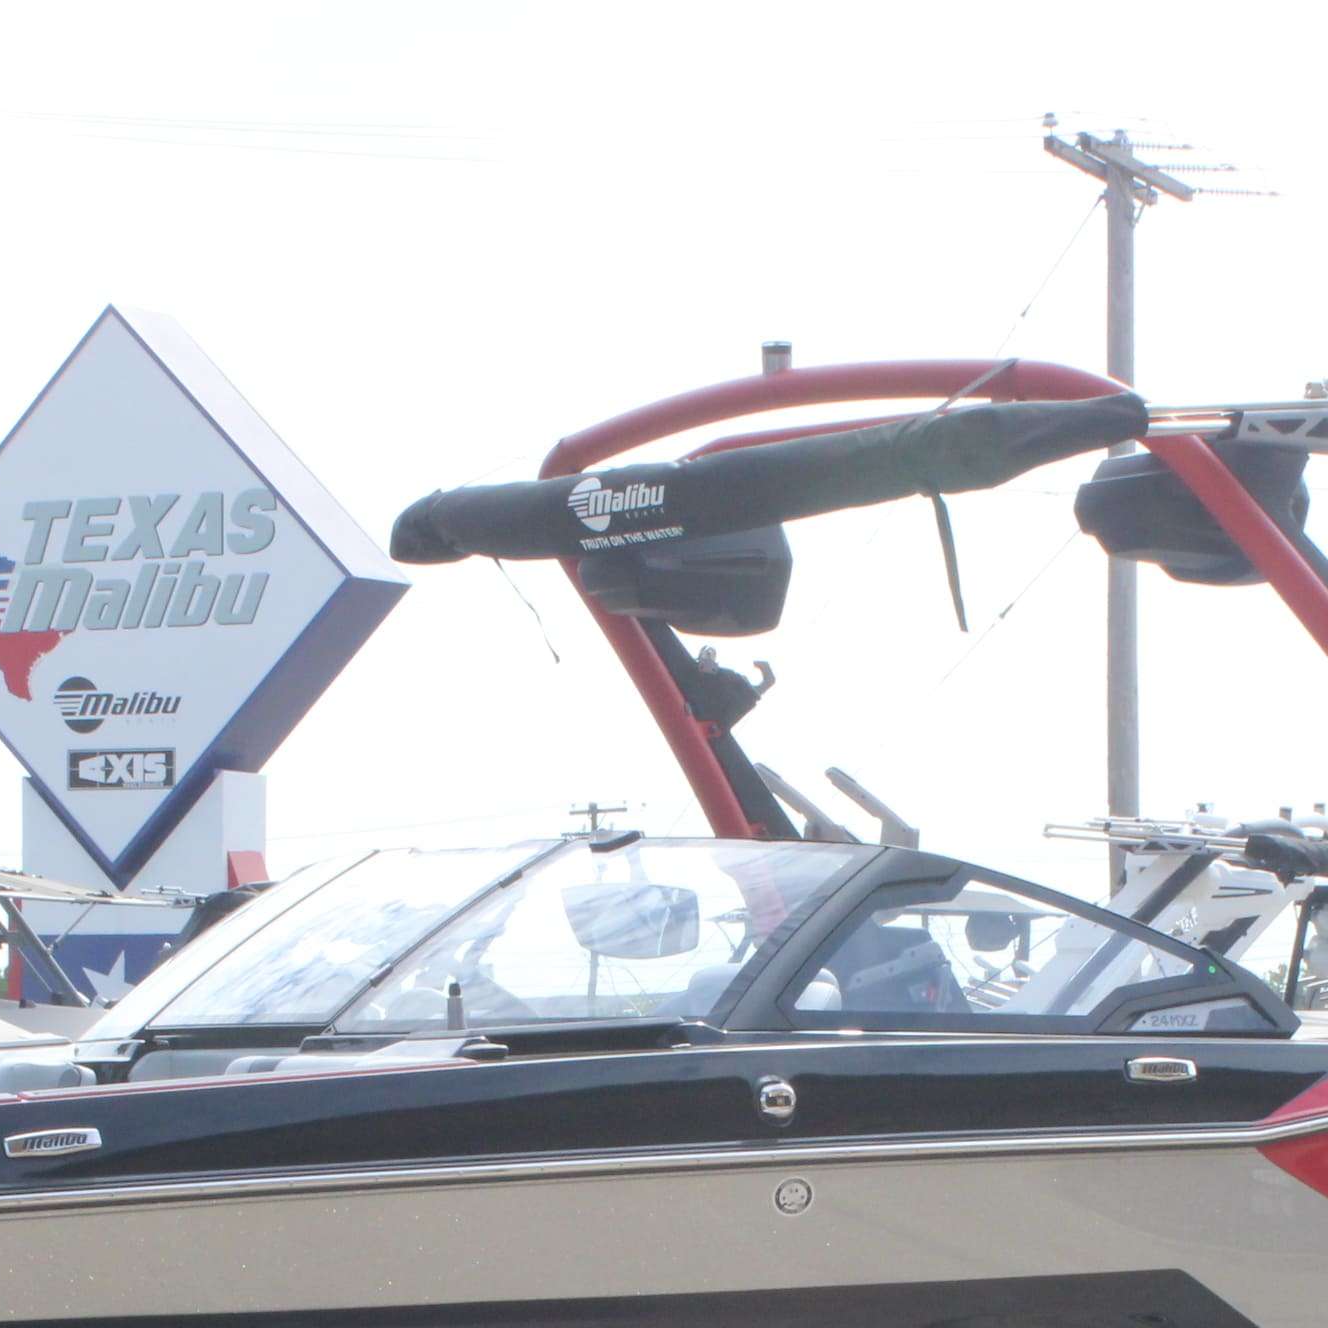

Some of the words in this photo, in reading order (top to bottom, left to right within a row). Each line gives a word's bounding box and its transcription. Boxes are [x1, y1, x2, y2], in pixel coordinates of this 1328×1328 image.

[588, 482, 665, 516] Malibu
[21, 488, 278, 566] TEXAS
[579, 537, 611, 552] TRUTH
[609, 535, 625, 547] ON
[623, 532, 646, 544] THE
[0, 560, 271, 633] Malibu
[78, 691, 182, 716] Malibu
[78, 752, 167, 784] AXIS
